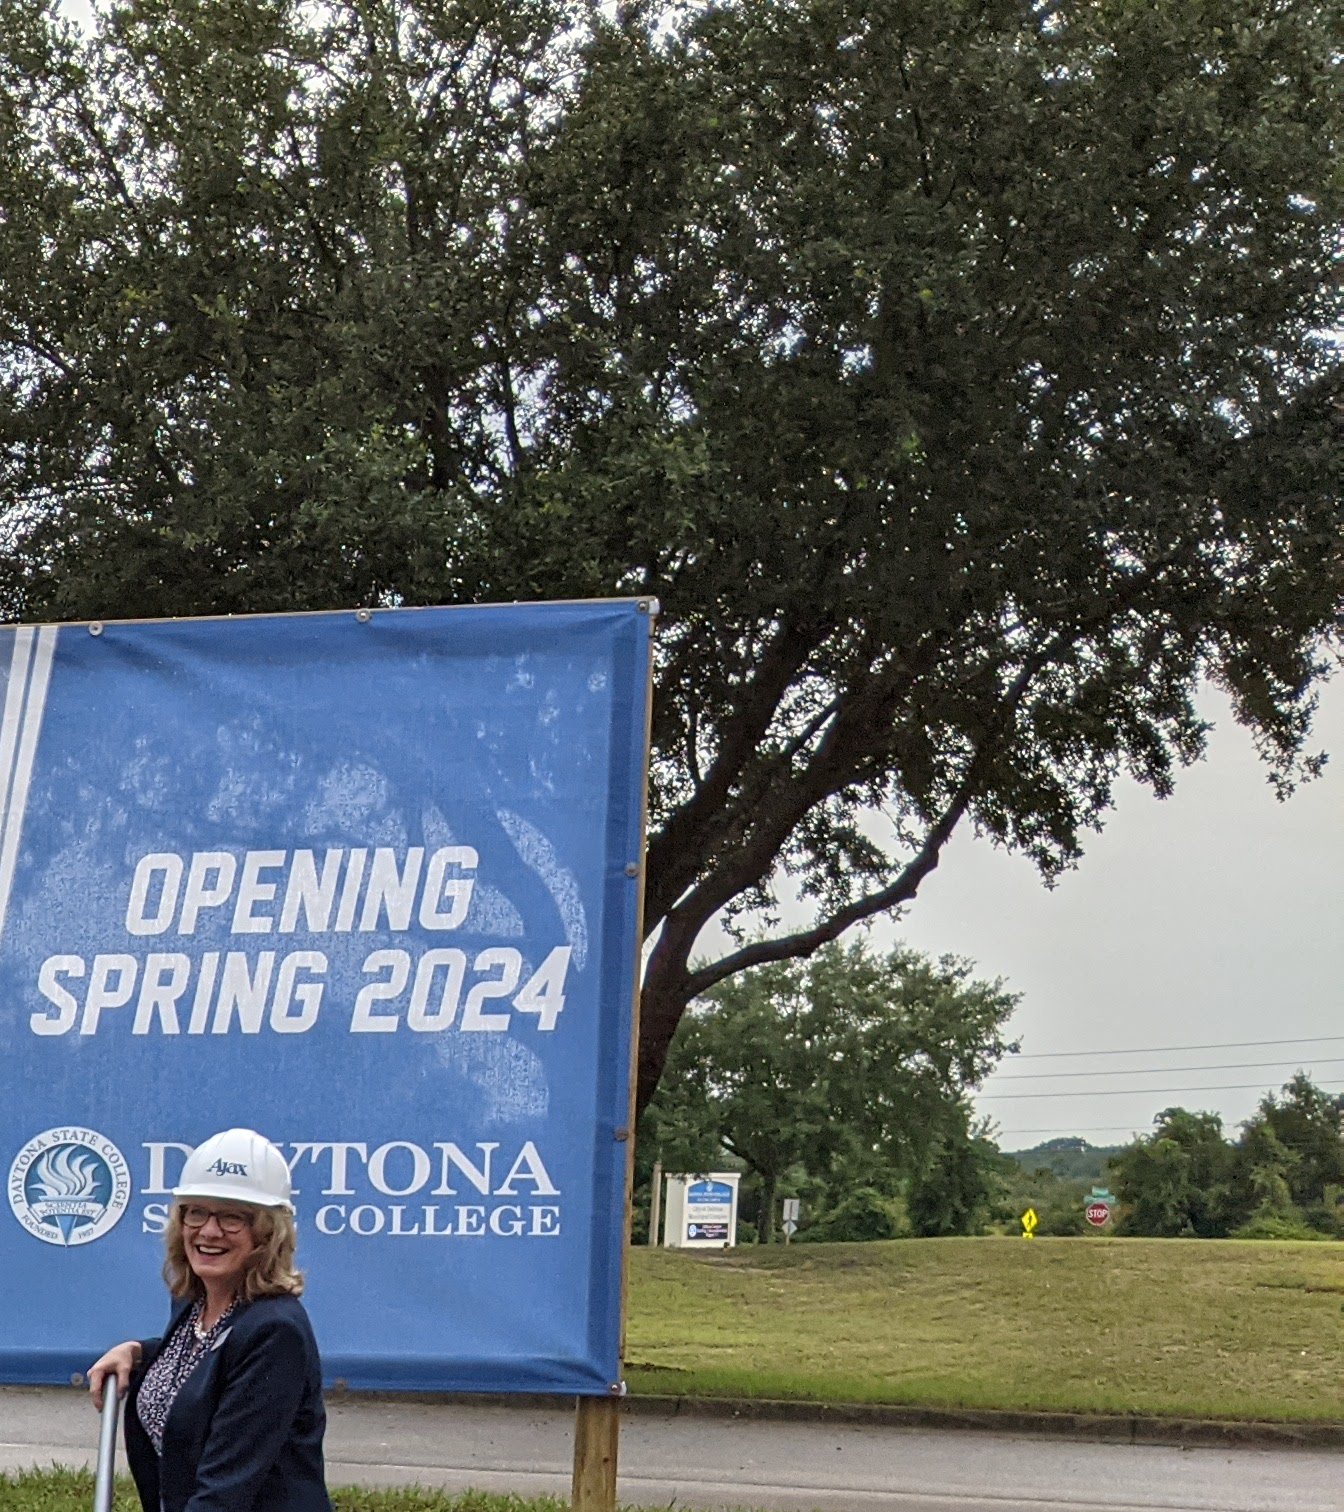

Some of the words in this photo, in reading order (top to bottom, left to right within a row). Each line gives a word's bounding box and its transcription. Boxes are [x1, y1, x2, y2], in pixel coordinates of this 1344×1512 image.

[124, 845, 480, 936] OPENING
[30, 949, 329, 1036] SPRING
[349, 945, 572, 1033] 2024
[12, 1139, 47, 1205] DAYTONA
[52, 1129, 99, 1146] STATE
[101, 1143, 128, 1209] COLLEGE
[141, 1141, 560, 1196] DYTONA
[21, 1214, 59, 1240] FOUNDED
[315, 1204, 561, 1236] COLLEGE
[1087, 1209, 1108, 1218] STOP
